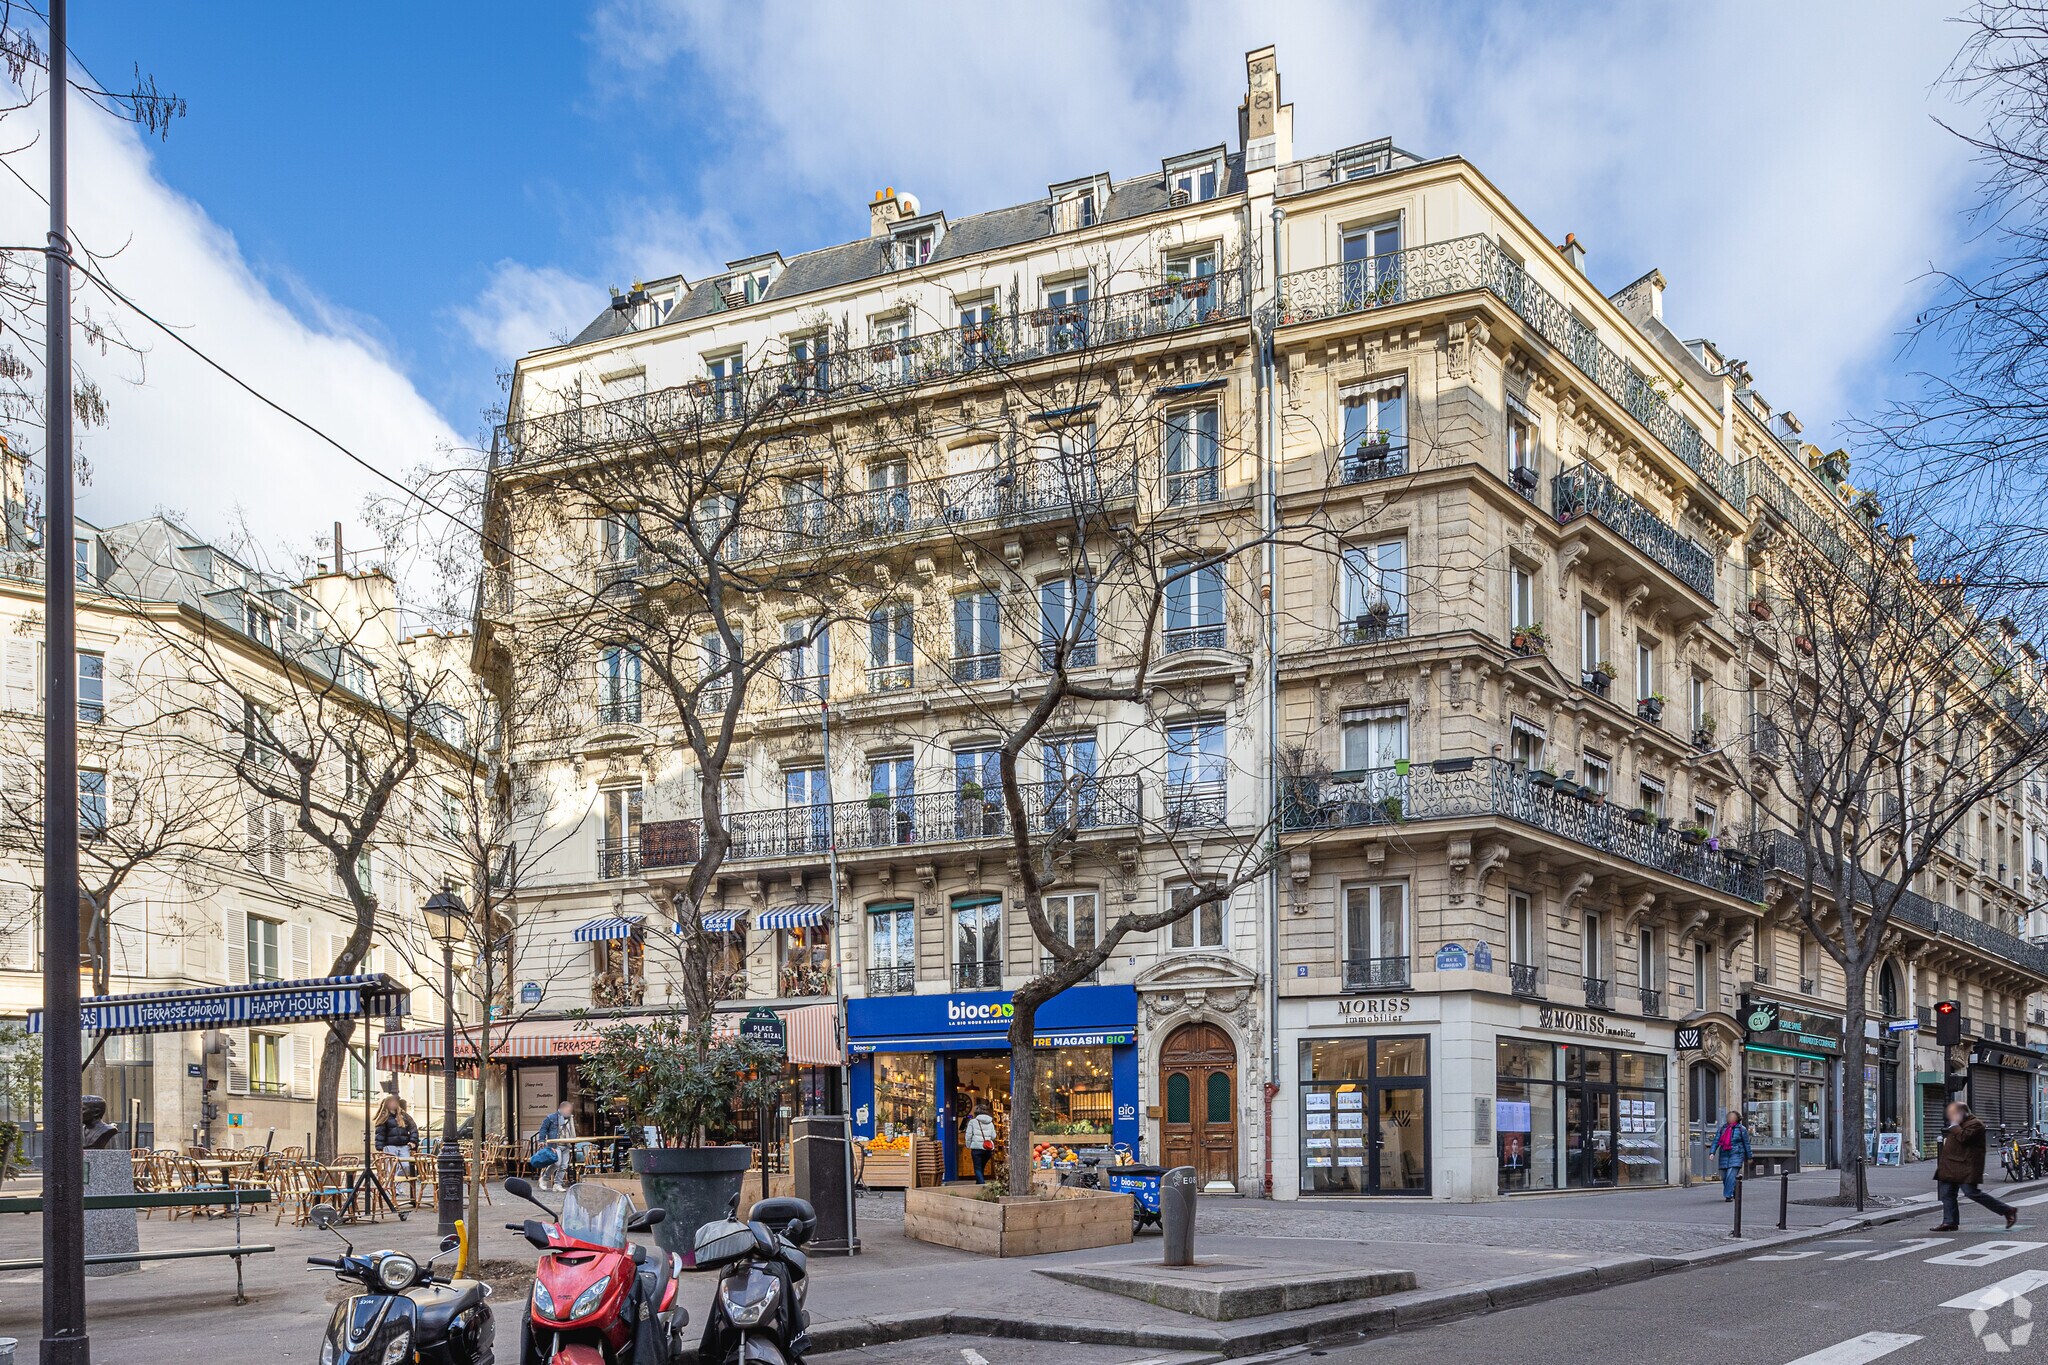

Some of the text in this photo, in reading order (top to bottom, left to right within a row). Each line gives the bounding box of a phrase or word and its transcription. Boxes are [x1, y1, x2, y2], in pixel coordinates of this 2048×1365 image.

[1300, 967, 1306, 976] 2
[142, 1003, 226, 1021] TERRASSE CHORON
[251, 997, 330, 1014] HAPPY HOURS
[948, 1000, 1014, 1020] biocoo
[1338, 998, 1410, 1015] MORISS
[81, 1012, 96, 1026] PAS
[1345, 1014, 1402, 1024] immobilier
[1554, 1010, 1636, 1038] MORISS immobilier
[763, 1032, 782, 1040] RIZAL
[1033, 1035, 1125, 1046] TRE MAGASIN BIO
[454, 1045, 510, 1054] BAR BRSERIE
[552, 1040, 596, 1052] TERRASSE
[1120, 1176, 1147, 1190] biocoop
